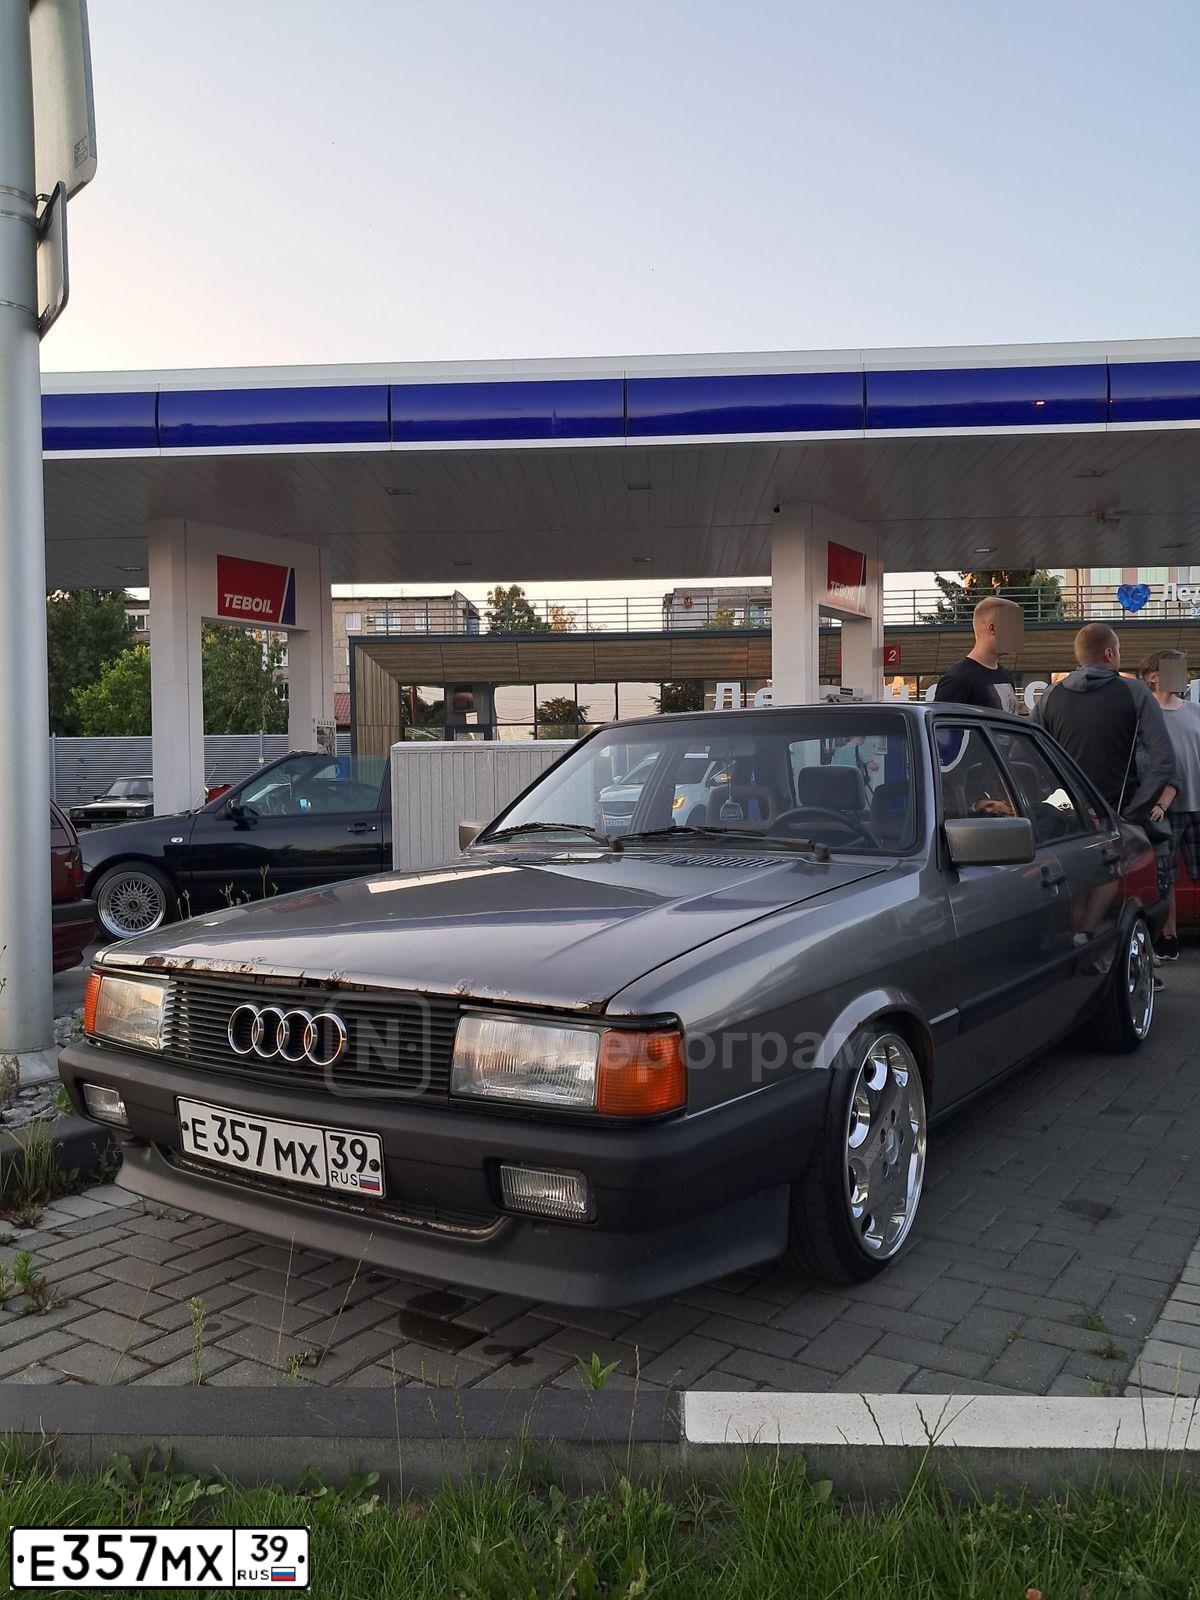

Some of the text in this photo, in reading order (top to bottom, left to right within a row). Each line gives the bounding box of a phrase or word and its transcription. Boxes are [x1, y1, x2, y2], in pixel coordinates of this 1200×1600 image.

[830, 580, 855, 601] TEBOIL
[223, 593, 274, 614] TEBOIL
[888, 649, 897, 662] 2
[190, 1113, 368, 1179] Е357МХ 39
[330, 1170, 359, 1186] RUS
